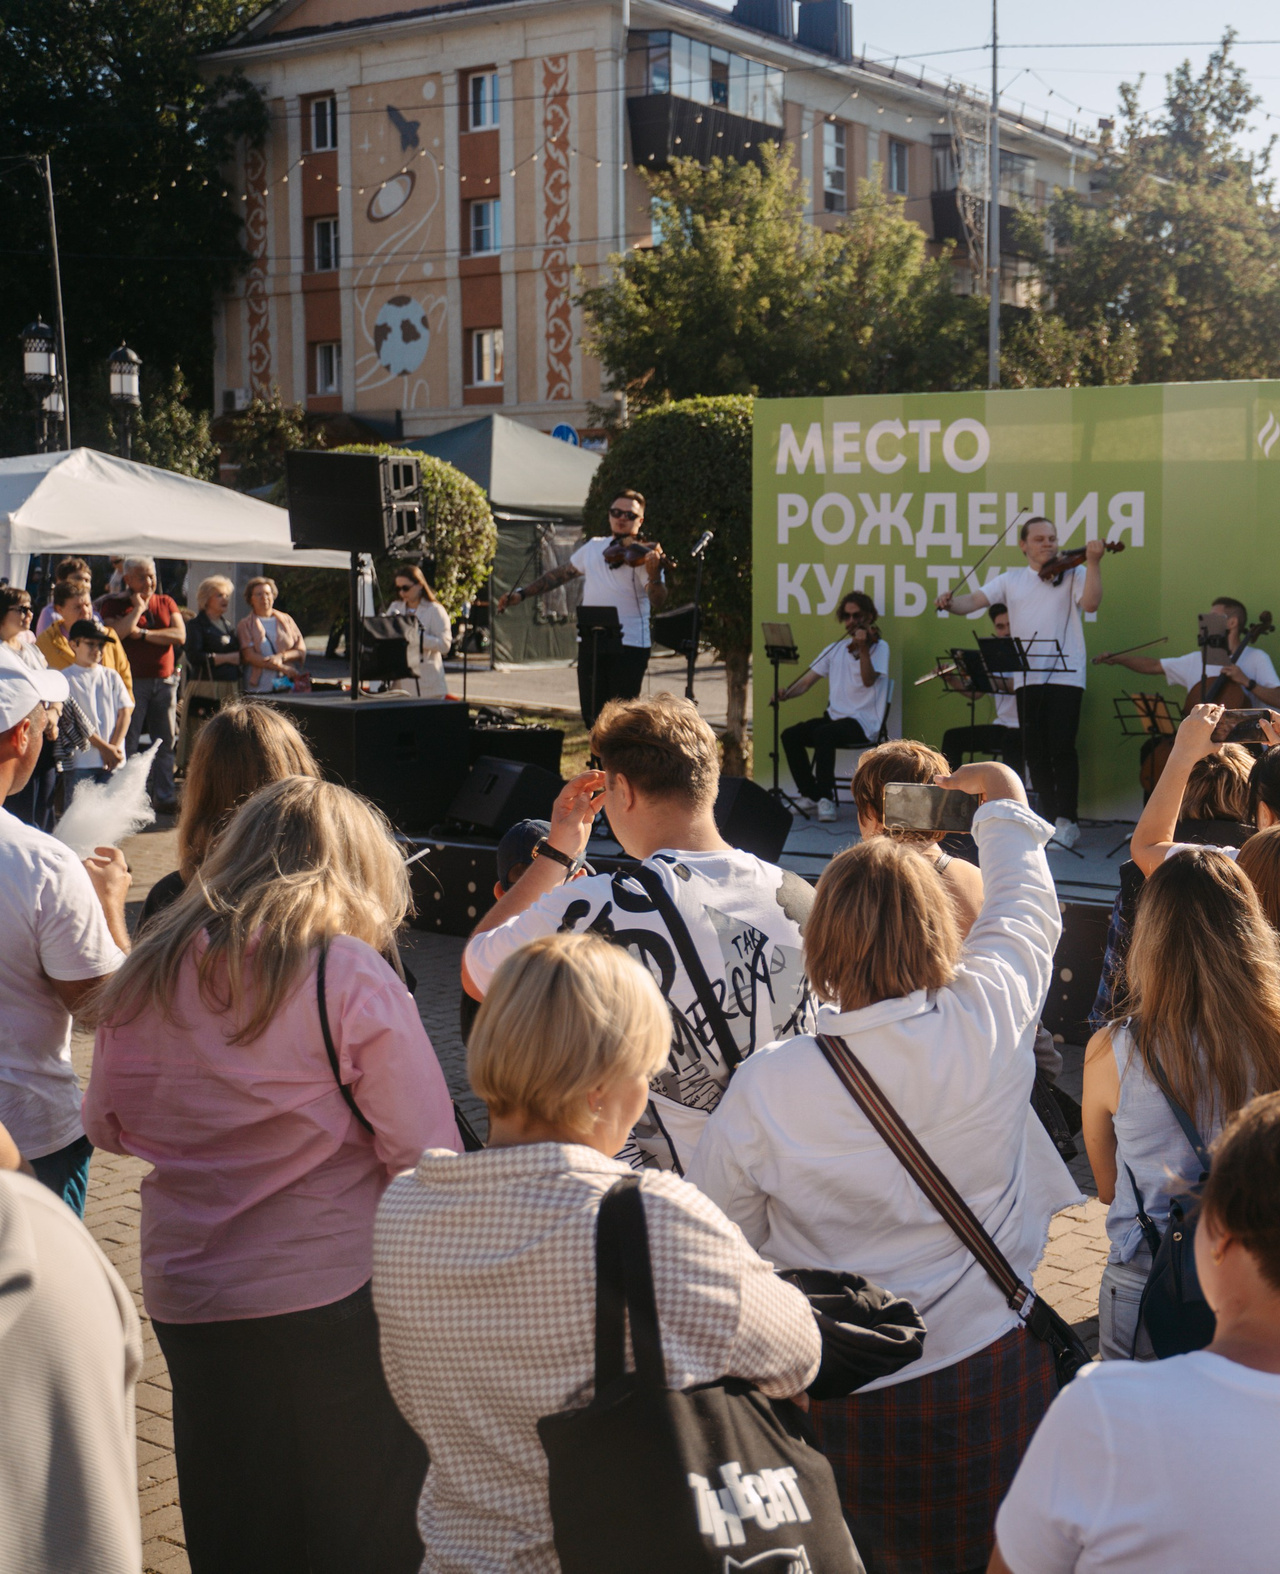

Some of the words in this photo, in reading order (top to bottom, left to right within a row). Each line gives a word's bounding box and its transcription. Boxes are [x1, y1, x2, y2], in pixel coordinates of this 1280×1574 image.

[775, 418, 990, 475] МЕСТО
[777, 491, 1145, 559] РОЖДЕНИЯ
[777, 563, 1097, 622] КУЛЬТУ
